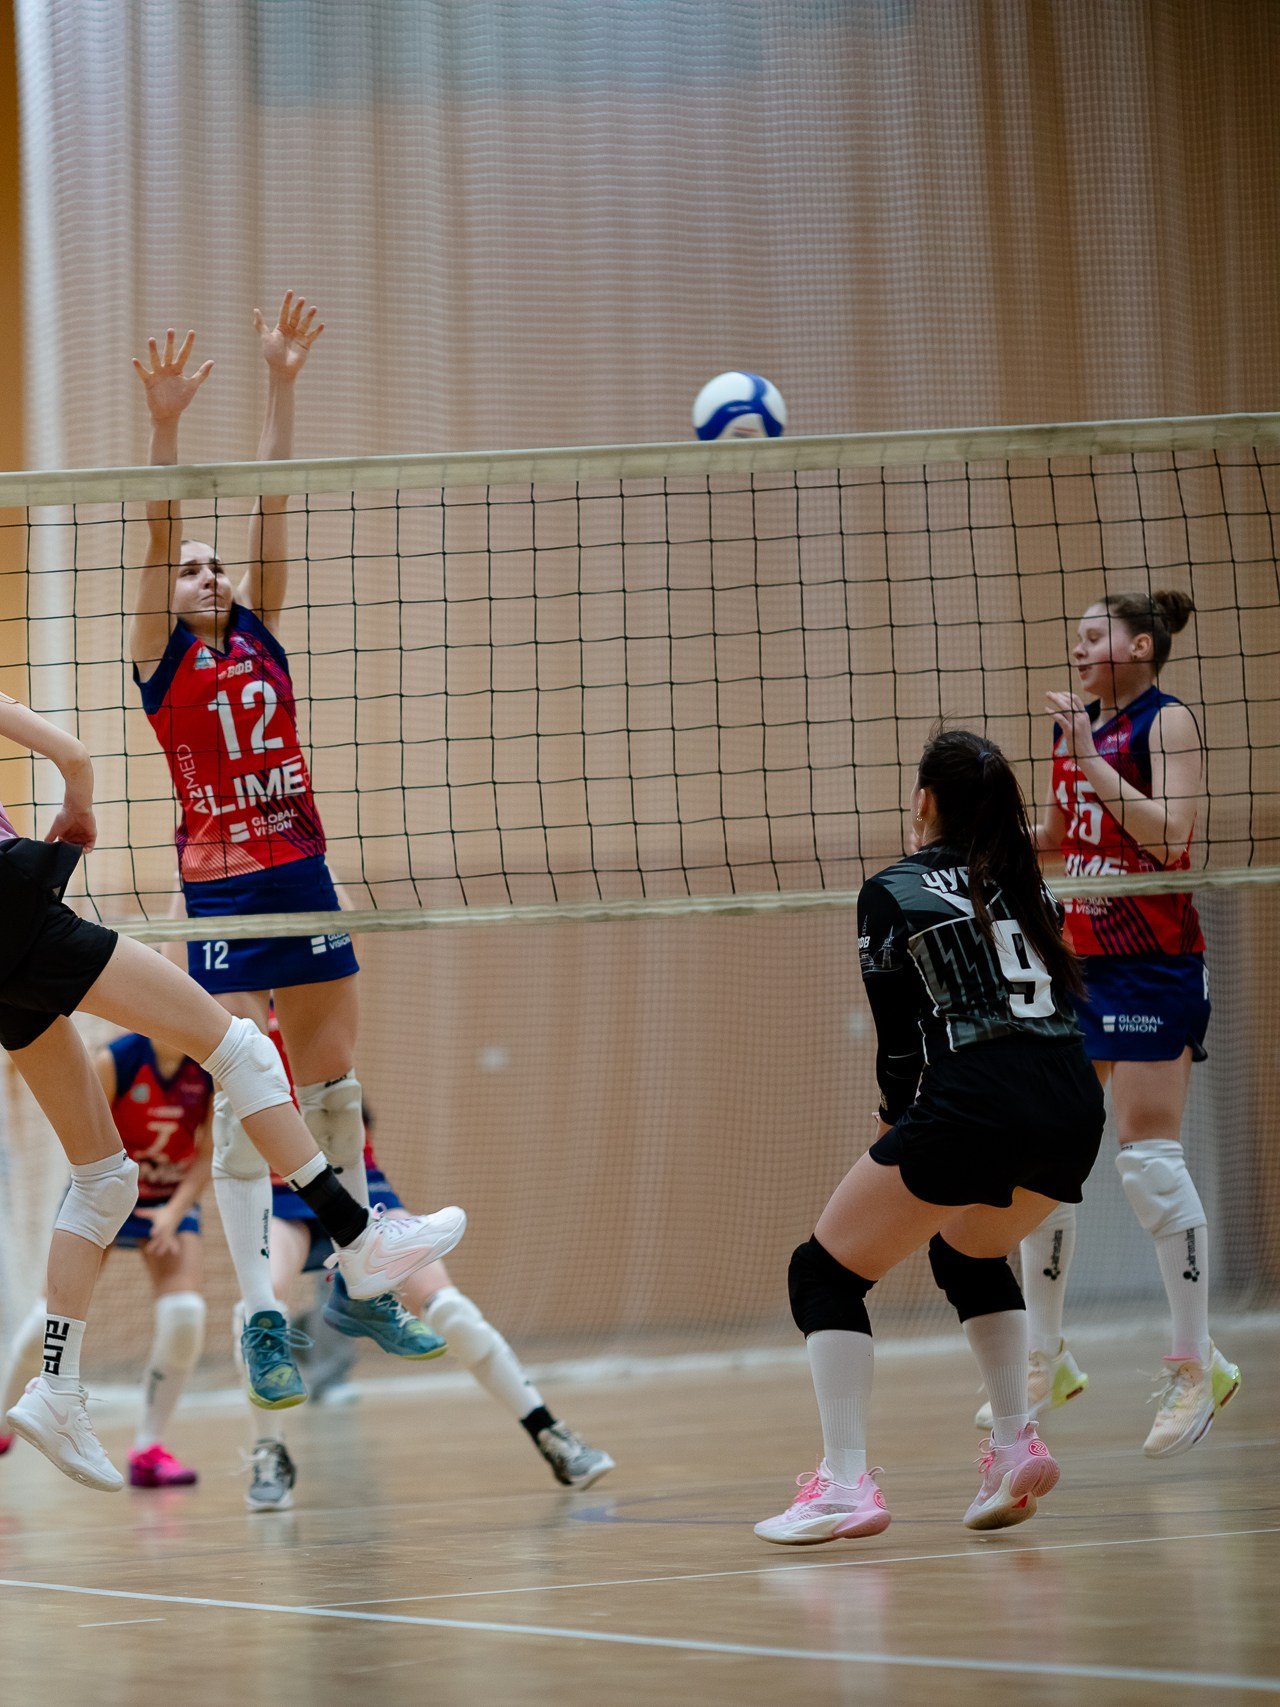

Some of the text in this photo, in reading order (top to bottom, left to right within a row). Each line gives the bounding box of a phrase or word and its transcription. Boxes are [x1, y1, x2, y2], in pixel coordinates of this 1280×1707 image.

[207, 680, 284, 761] 12
[251, 808, 298, 827] GLOBAL
[254, 819, 294, 838] VISION
[1056, 780, 1103, 845] 15
[202, 940, 229, 970] 12
[991, 919, 1056, 1018] 9
[1119, 1014, 1164, 1025] GLOBAL
[1119, 1024, 1158, 1033] VISION
[147, 1121, 179, 1156] 7
[43, 1320, 70, 1376] ELITE
